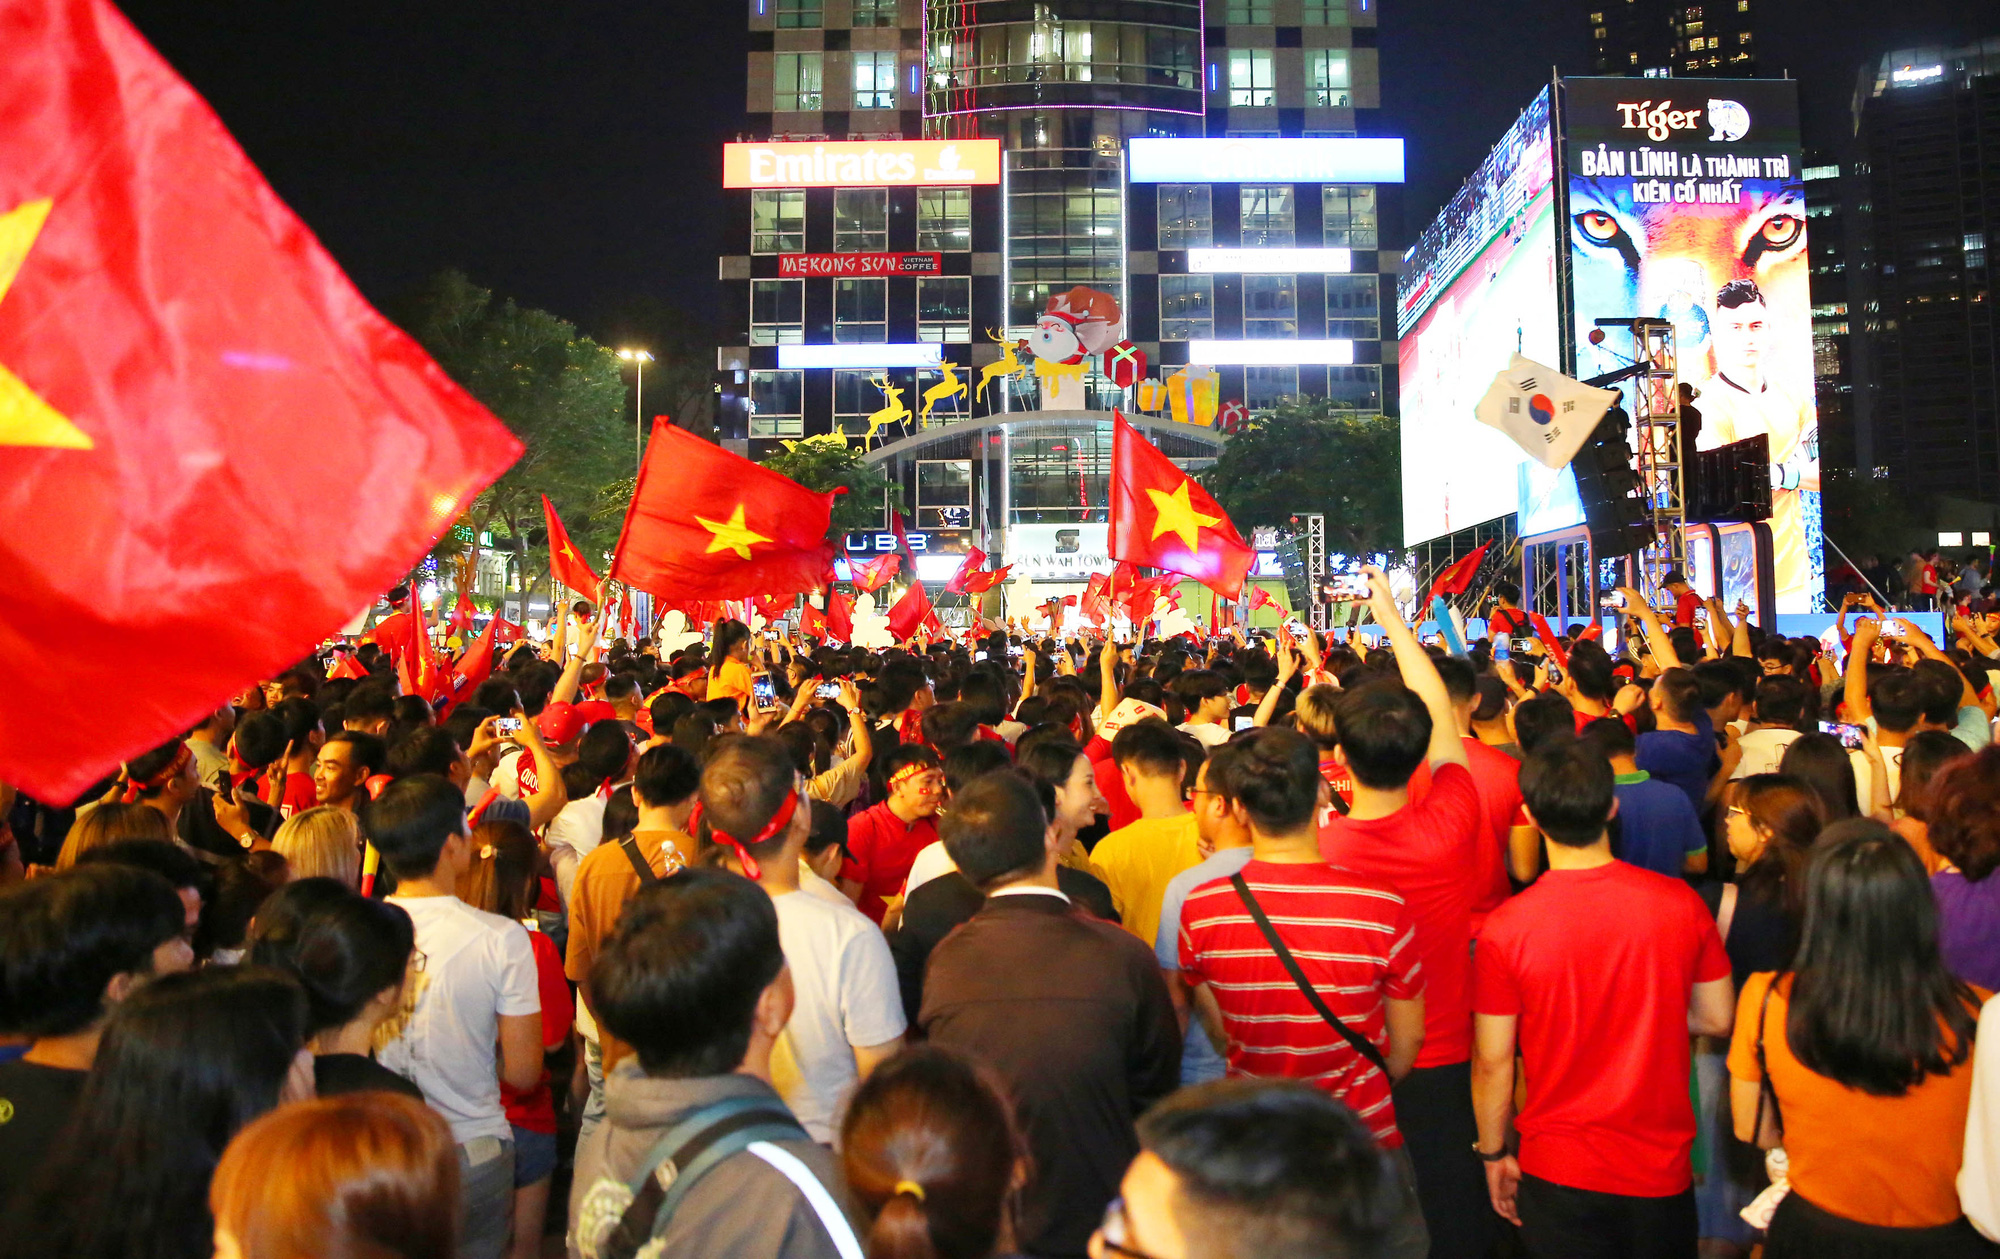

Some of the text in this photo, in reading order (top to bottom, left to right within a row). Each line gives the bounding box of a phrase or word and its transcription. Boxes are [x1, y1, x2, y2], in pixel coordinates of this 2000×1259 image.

[1616, 100, 1702, 142] Tiger
[749, 146, 916, 183] Emirates
[1581, 143, 1790, 178] BẢN LĨNH LÀ THÀNH TRÌ
[1632, 177, 1743, 204] KIÊN CỐ NHẤT
[781, 256, 896, 274] MEKONG SUN
[1045, 553, 1073, 567] WAH
